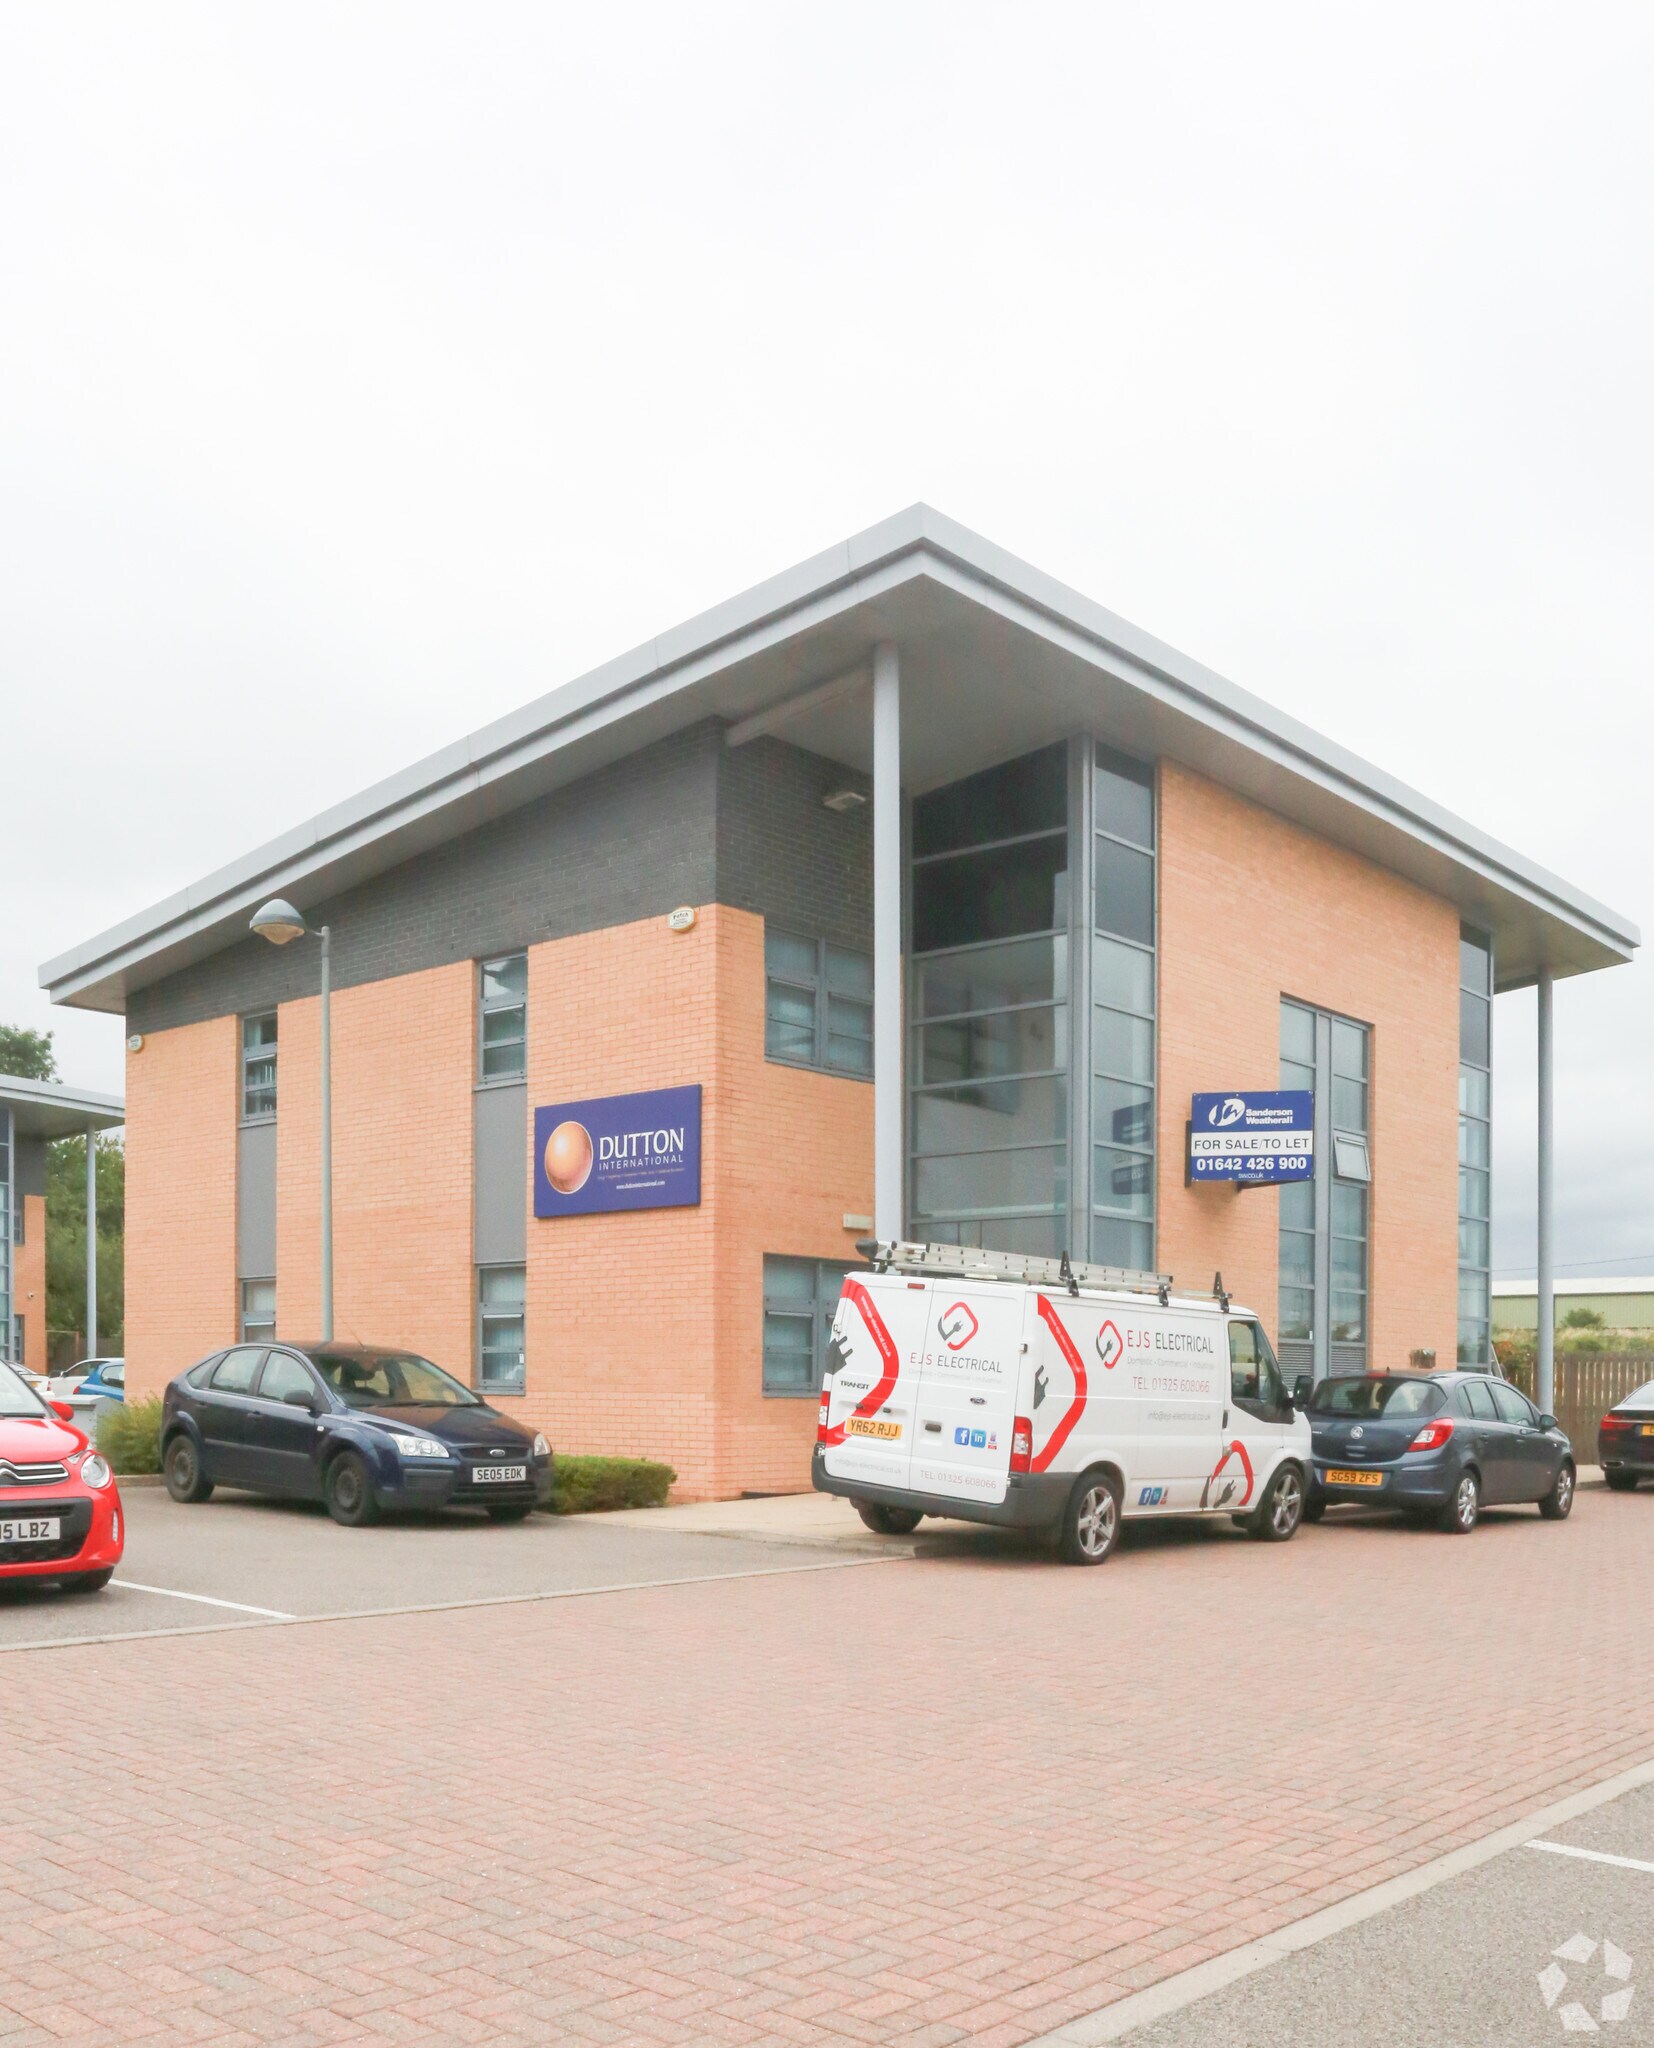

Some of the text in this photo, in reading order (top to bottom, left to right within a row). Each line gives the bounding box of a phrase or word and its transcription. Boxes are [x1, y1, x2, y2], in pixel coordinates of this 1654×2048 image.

[1246, 1108, 1293, 1117] Sanderson
[1246, 1116, 1293, 1124] Weatherall
[599, 1127, 684, 1160] DUTTON
[1194, 1140, 1220, 1150] FOR
[1286, 1138, 1309, 1149] LET
[599, 1154, 684, 1171] INTERNATIONAL
[1196, 1156, 1307, 1171] 01642 426 900
[1127, 1329, 1214, 1354] EJS ELECTRICAL
[937, 1355, 1003, 1373] ELECTRICAL
[840, 1380, 869, 1390] TRANSIT
[1152, 1377, 1178, 1391] 01325
[1180, 1379, 1210, 1393] 608066
[851, 1419, 899, 1437] YR62 RJJ
[477, 1467, 522, 1480] SE05 EDK
[938, 1472, 963, 1484] 01325
[965, 1477, 996, 1489] 608066
[1331, 1471, 1378, 1484] SG59 ZFS
[18, 1521, 50, 1538] LBZ
